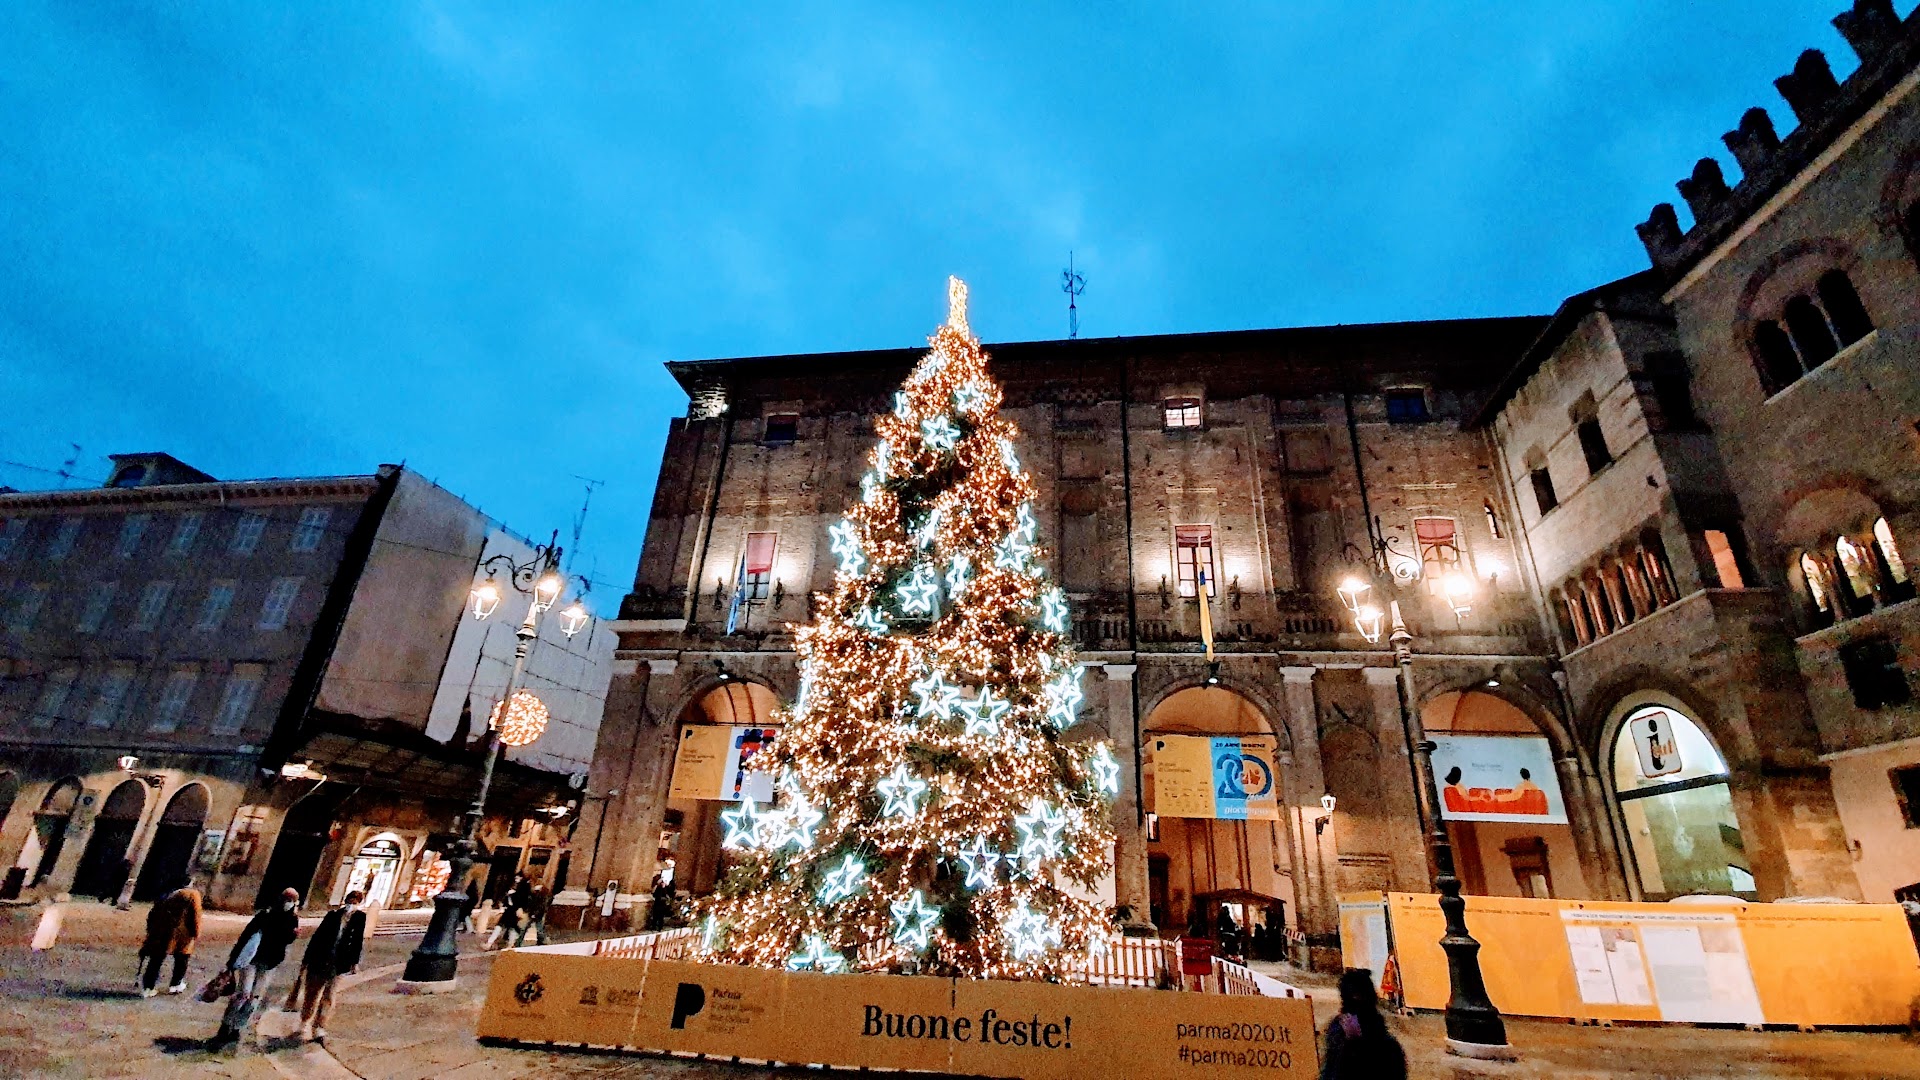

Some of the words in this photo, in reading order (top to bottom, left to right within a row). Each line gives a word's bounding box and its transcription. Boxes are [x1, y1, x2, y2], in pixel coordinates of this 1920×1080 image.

[861, 1004, 971, 1042] Buone
[979, 1009, 1073, 1049] feste!
[1176, 1021, 1293, 1045] parma2020.it
[1178, 1046, 1292, 1070] #parma2020
